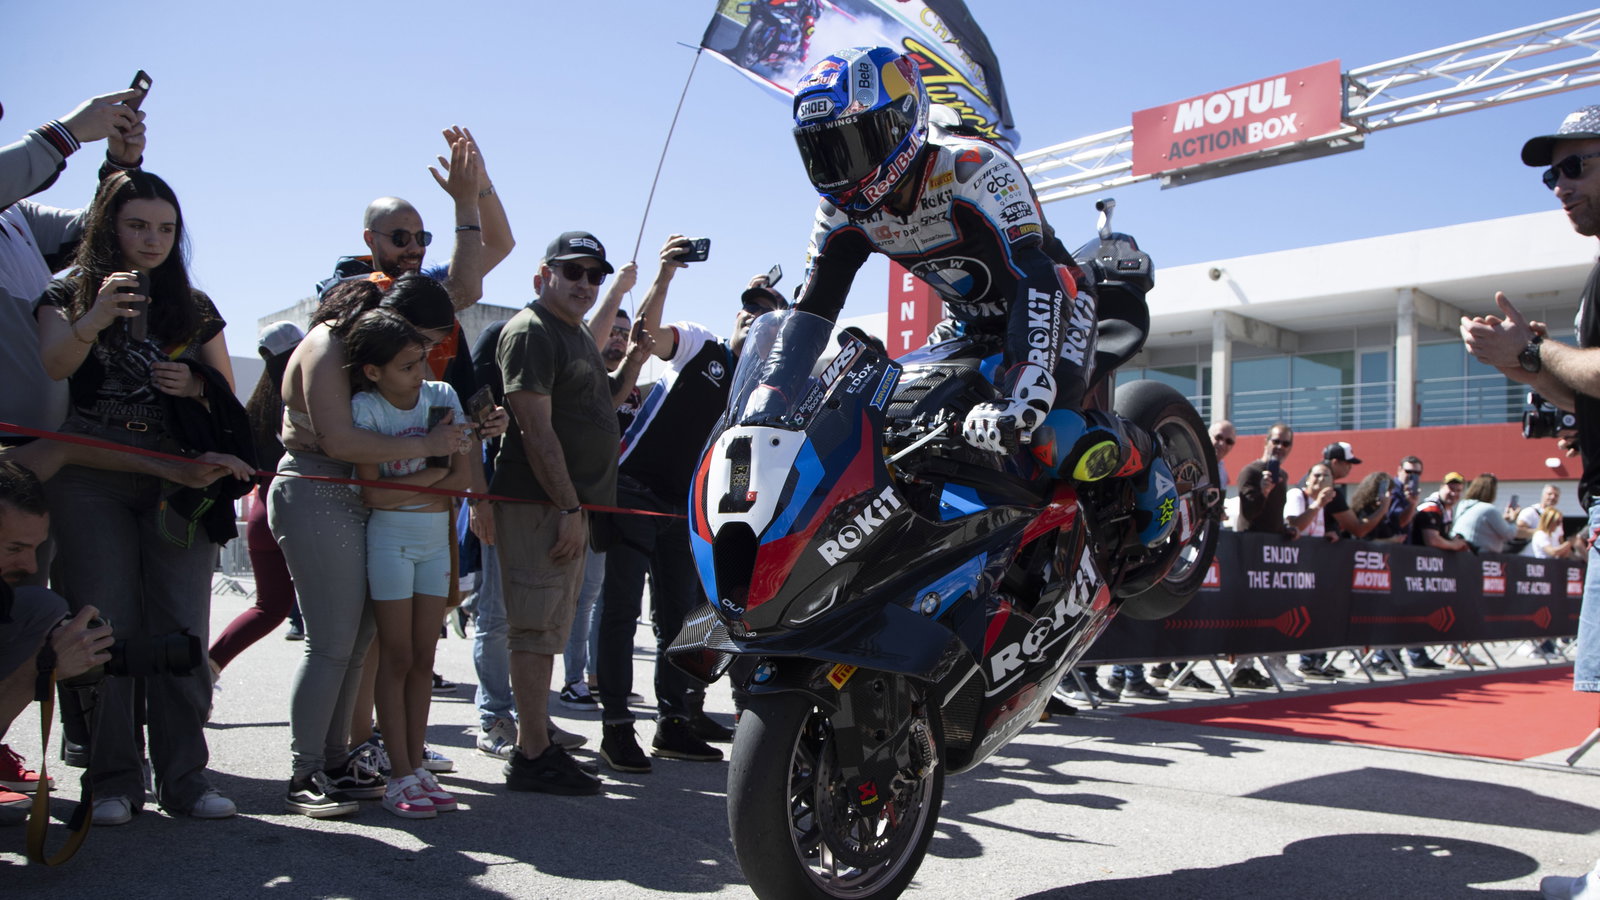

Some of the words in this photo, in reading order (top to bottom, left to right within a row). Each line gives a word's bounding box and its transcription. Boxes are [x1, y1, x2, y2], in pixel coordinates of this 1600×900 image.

[858, 62, 871, 88] Beta
[800, 100, 827, 117] SHOEI
[1173, 77, 1292, 133] MOTUL
[806, 124, 822, 134] YOU
[825, 116, 858, 129] WINGS
[863, 164, 900, 204] Red
[894, 133, 923, 174] Bull
[986, 173, 1015, 193] ebc
[1052, 289, 1063, 349] MOTORRAD
[822, 340, 856, 388] WRS
[846, 363, 874, 394] EDOX
[799, 384, 820, 413] Bonamici
[807, 391, 824, 413] Racing
[718, 435, 757, 513] 1
[817, 485, 902, 566] ROKiT
[1263, 545, 1300, 564] ENJOY
[1354, 551, 1391, 571] SBK
[1416, 556, 1444, 572] ENJOY
[1248, 571, 1270, 589] THE
[1272, 571, 1316, 589] ACTION!
[1353, 572, 1390, 587] MOTUL
[1405, 576, 1424, 592] THE
[1425, 577, 1457, 593] ACTION!
